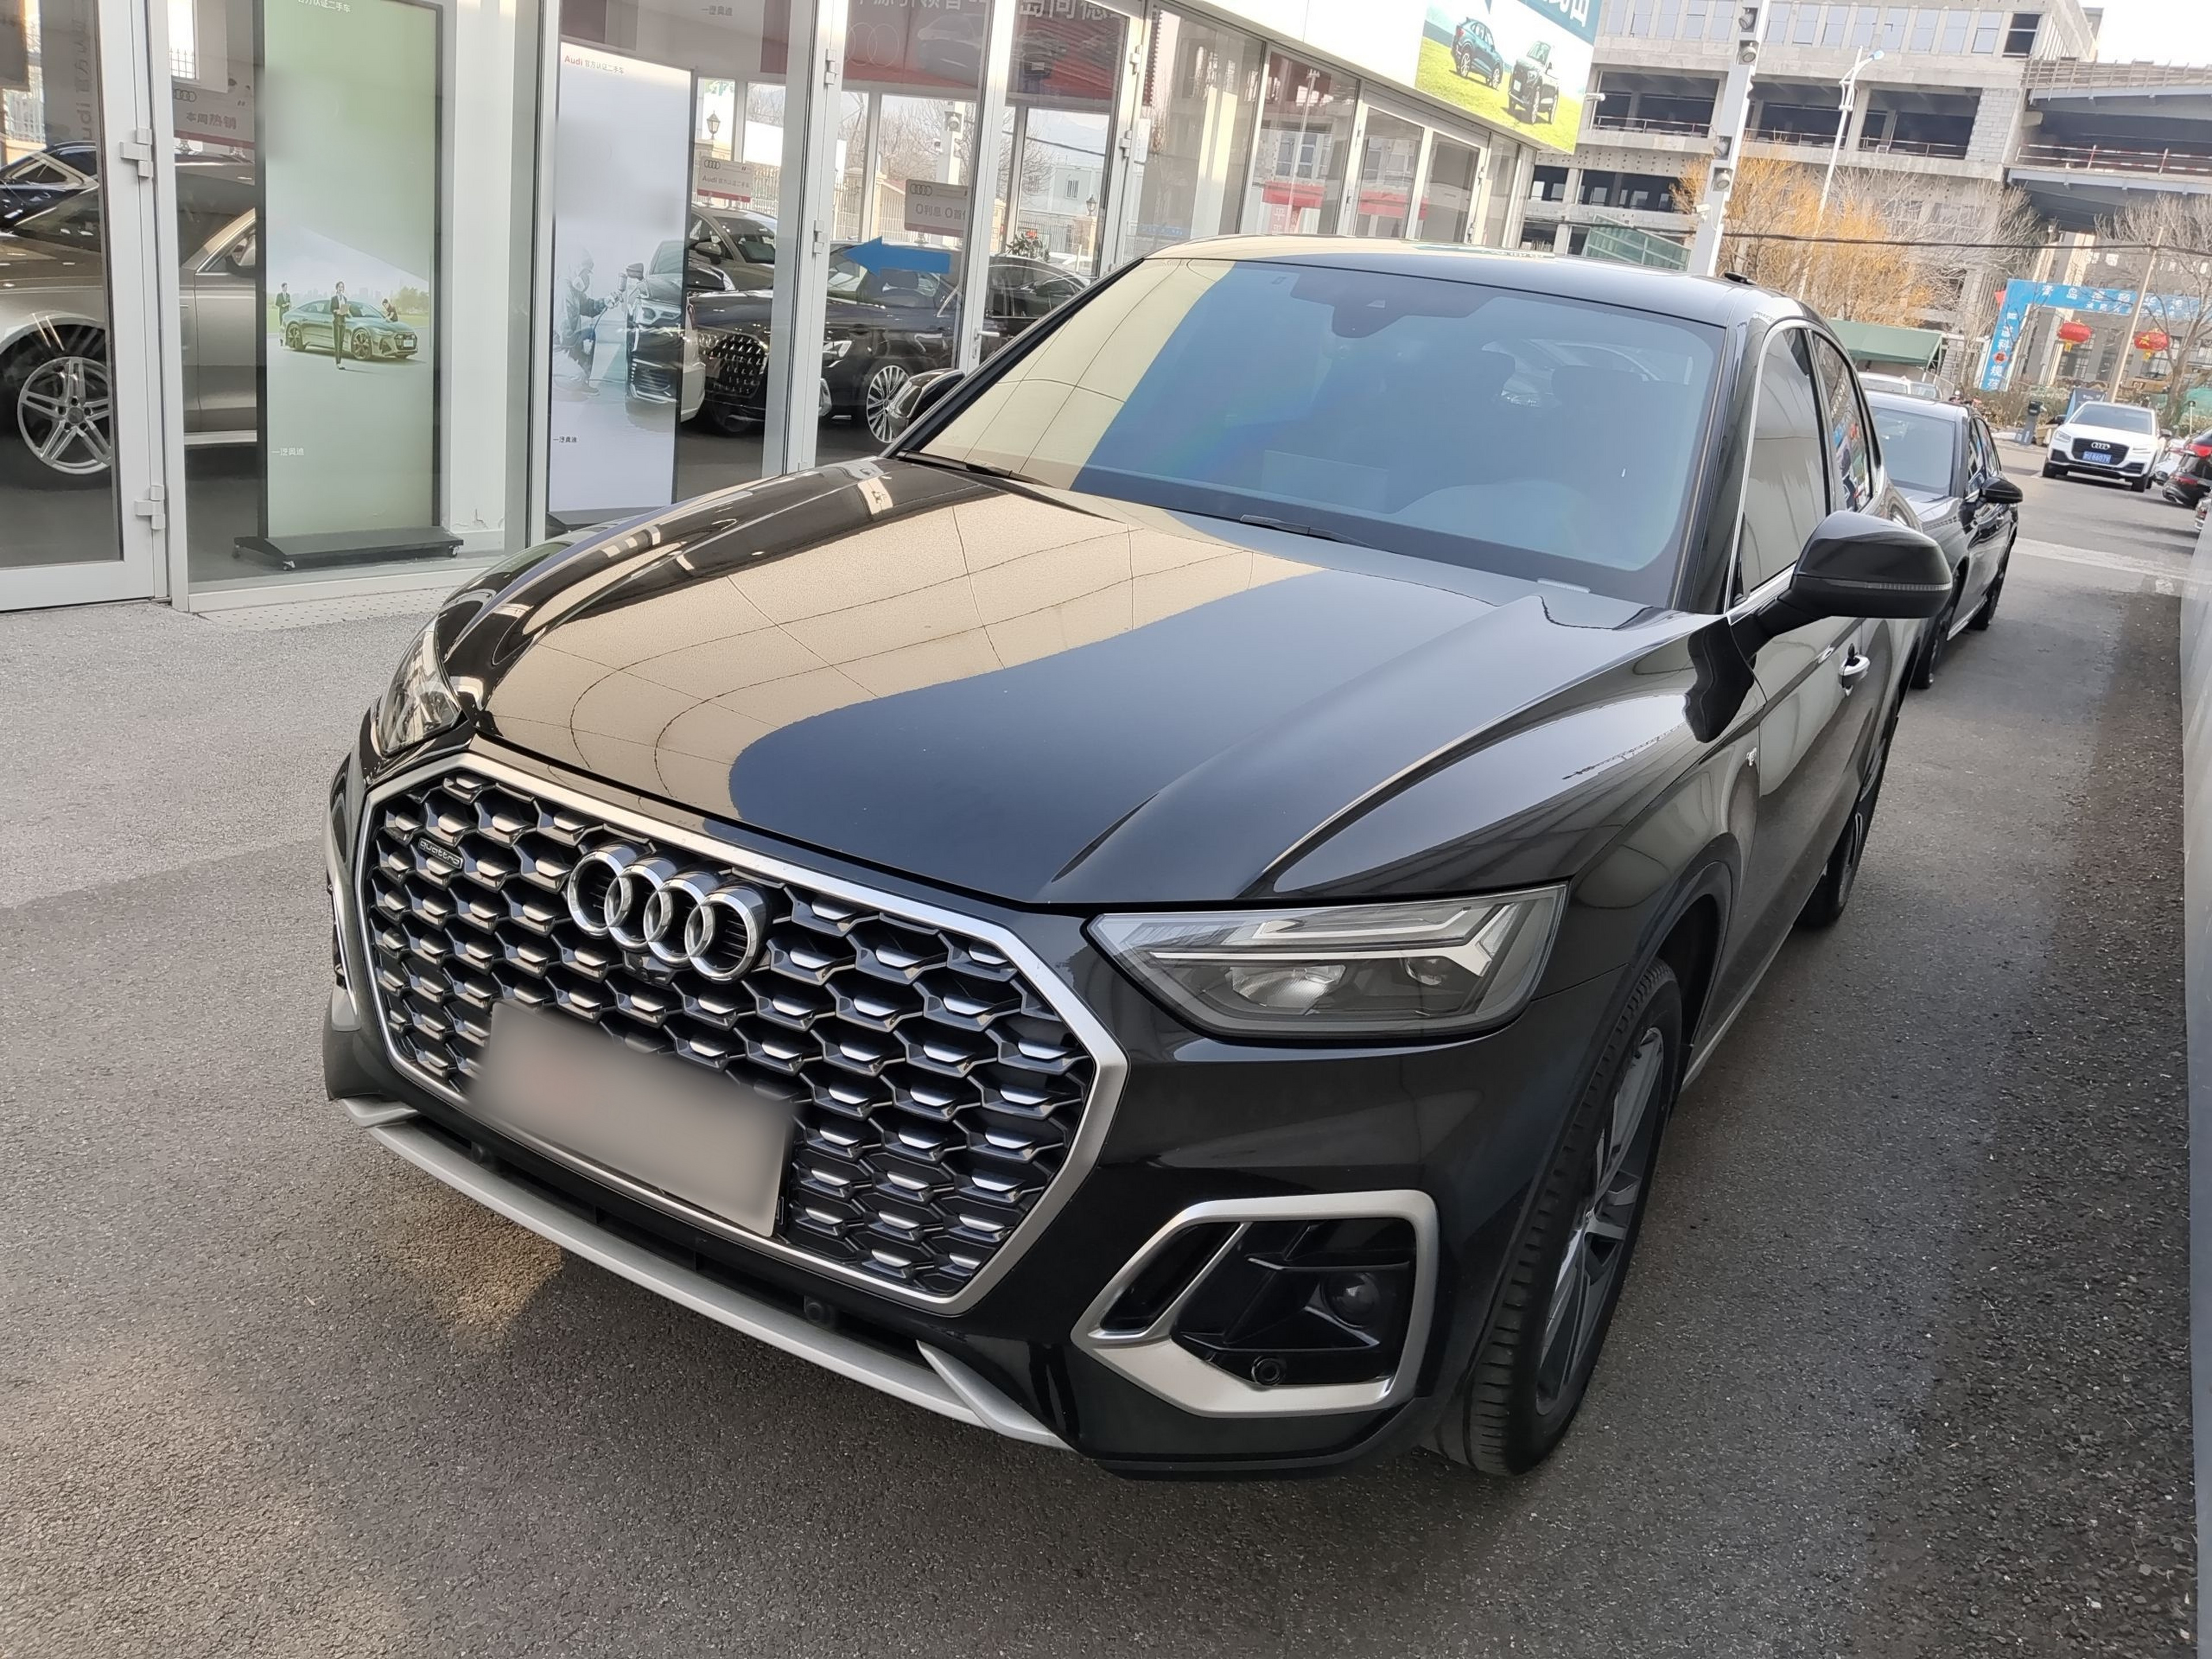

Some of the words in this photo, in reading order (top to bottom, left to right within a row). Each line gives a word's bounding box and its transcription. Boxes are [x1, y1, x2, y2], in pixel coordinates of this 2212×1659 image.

[565, 55, 583, 66] Audi
[702, 175, 718, 184] Audi
[419, 840, 460, 865] quattro
